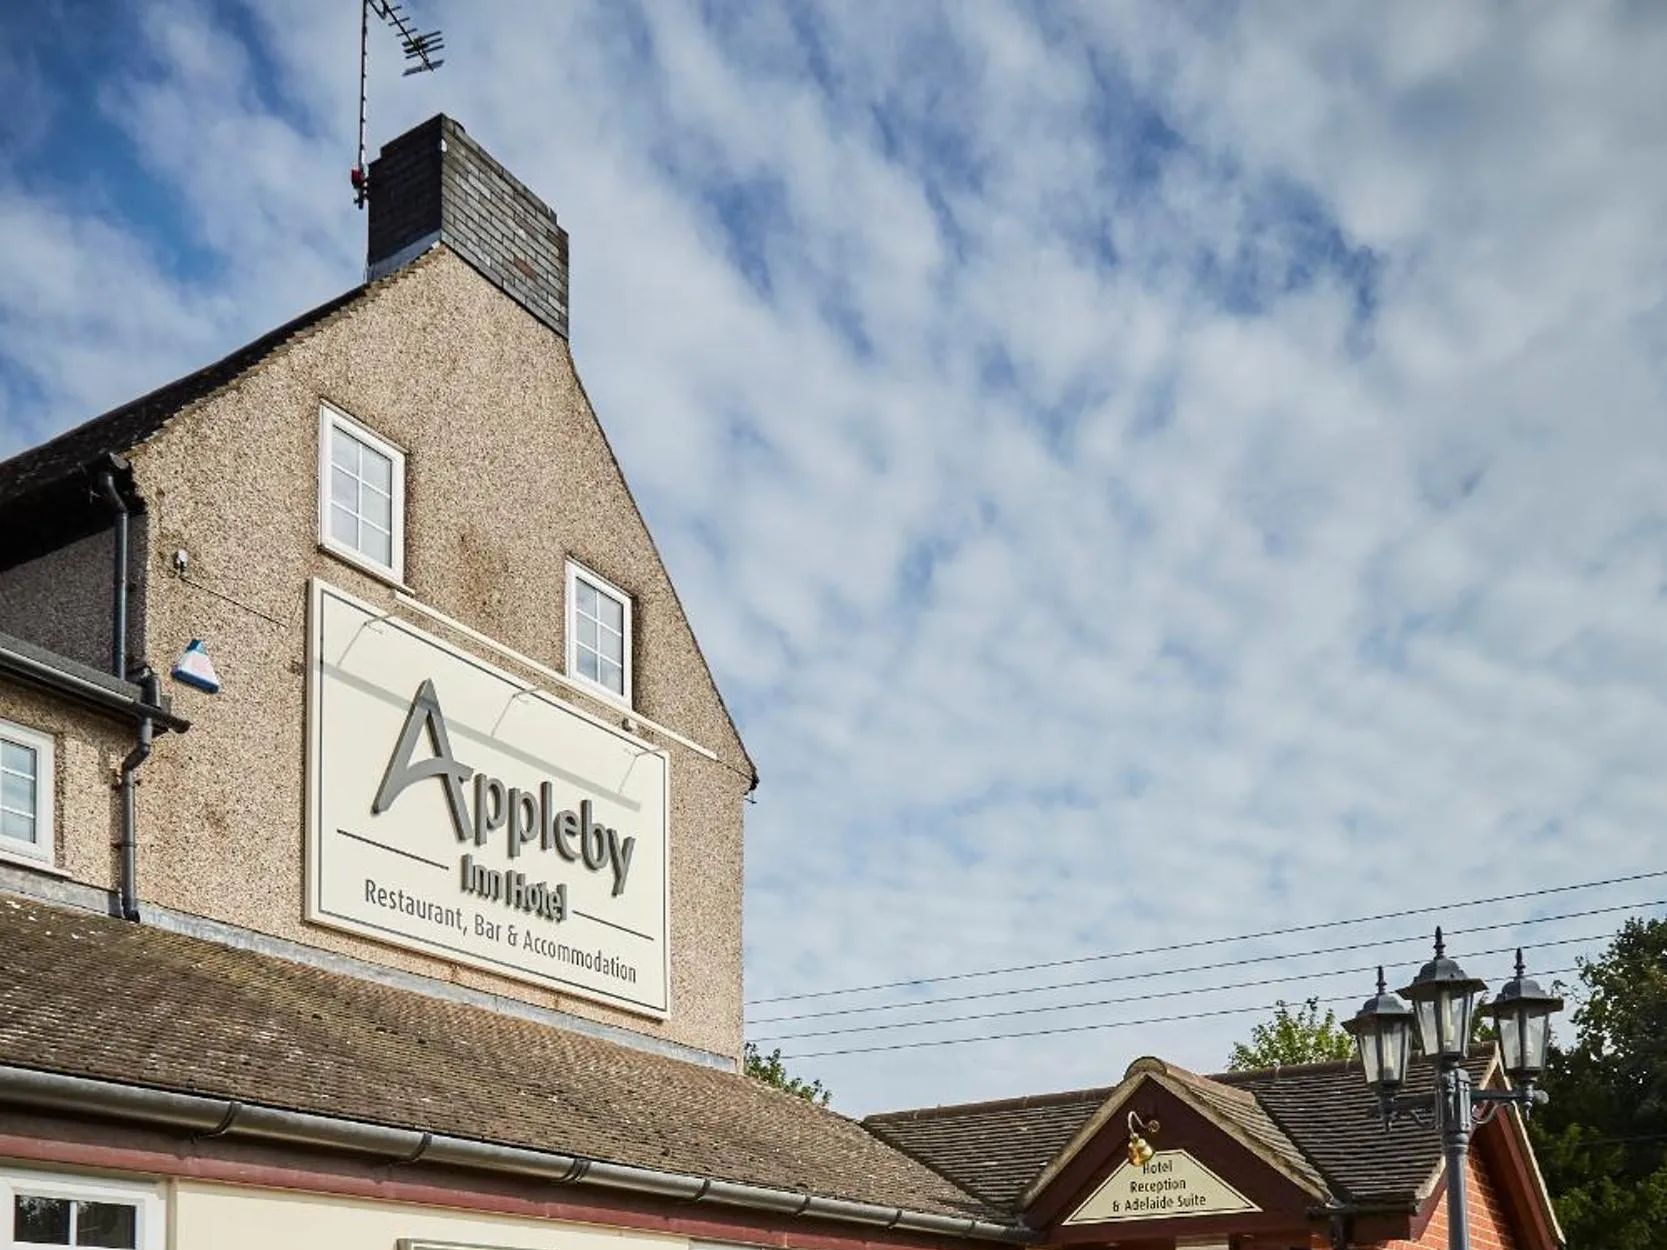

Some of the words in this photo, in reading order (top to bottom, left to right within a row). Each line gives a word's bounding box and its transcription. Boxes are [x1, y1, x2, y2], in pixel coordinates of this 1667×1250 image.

[371, 678, 636, 896] Appleby
[461, 853, 500, 899] Inn
[502, 869, 568, 922] Hotel
[365, 880, 468, 935] Restaurant,
[474, 914, 501, 942] Bar
[507, 926, 518, 947] &
[523, 934, 637, 984] Accommodation
[1130, 1178, 1186, 1194] Reception
[1142, 1160, 1173, 1174] Hotel
[1112, 1200, 1120, 1212] &
[1124, 1196, 1175, 1211] Adelaide
[1177, 1193, 1206, 1207] Suite
